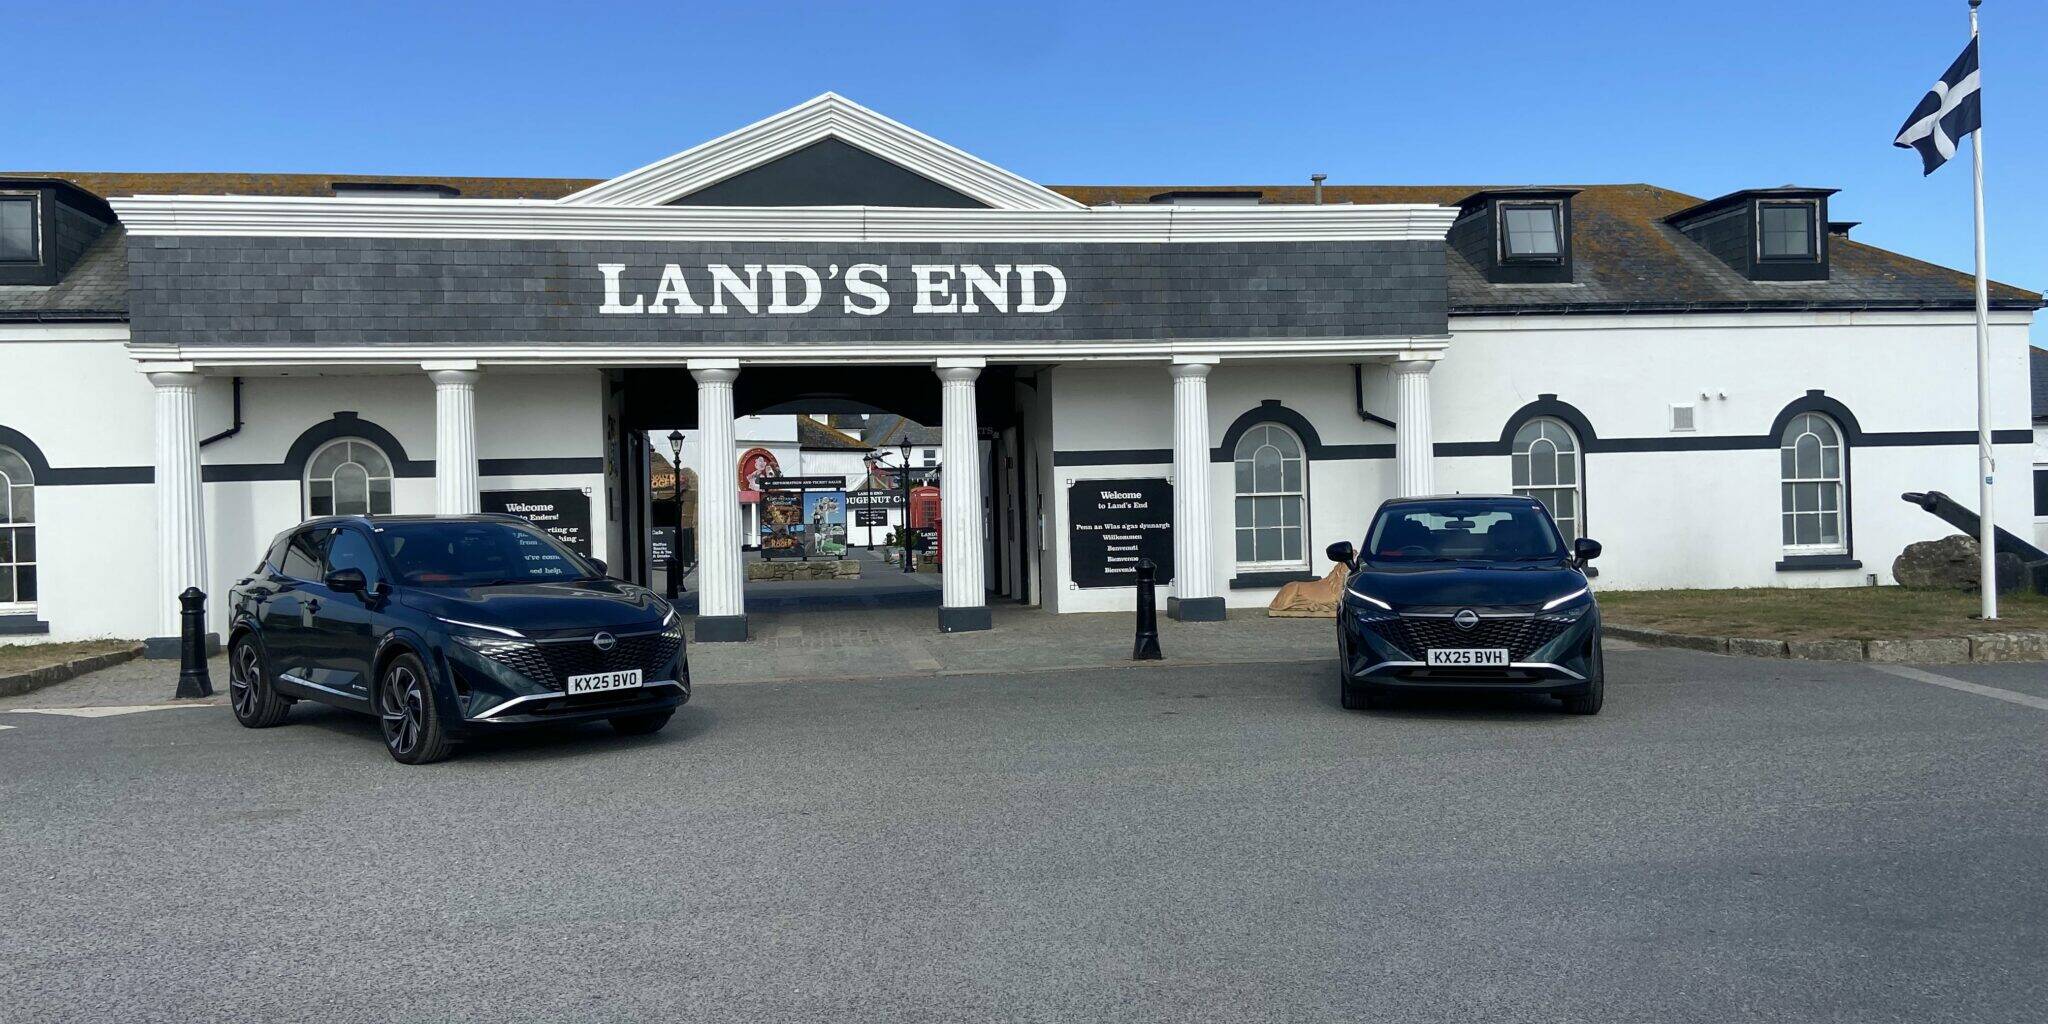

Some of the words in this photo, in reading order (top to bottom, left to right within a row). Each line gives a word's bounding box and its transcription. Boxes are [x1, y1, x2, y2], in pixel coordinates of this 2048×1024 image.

[598, 264, 891, 316] LAND'S
[912, 264, 1067, 314] END
[1100, 491, 1142, 499] Welcome
[506, 503, 554, 512] Welcome
[1434, 651, 1471, 664] KX25
[1474, 651, 1502, 664] BVH
[574, 675, 609, 691] KX25
[613, 672, 637, 688] BVO
